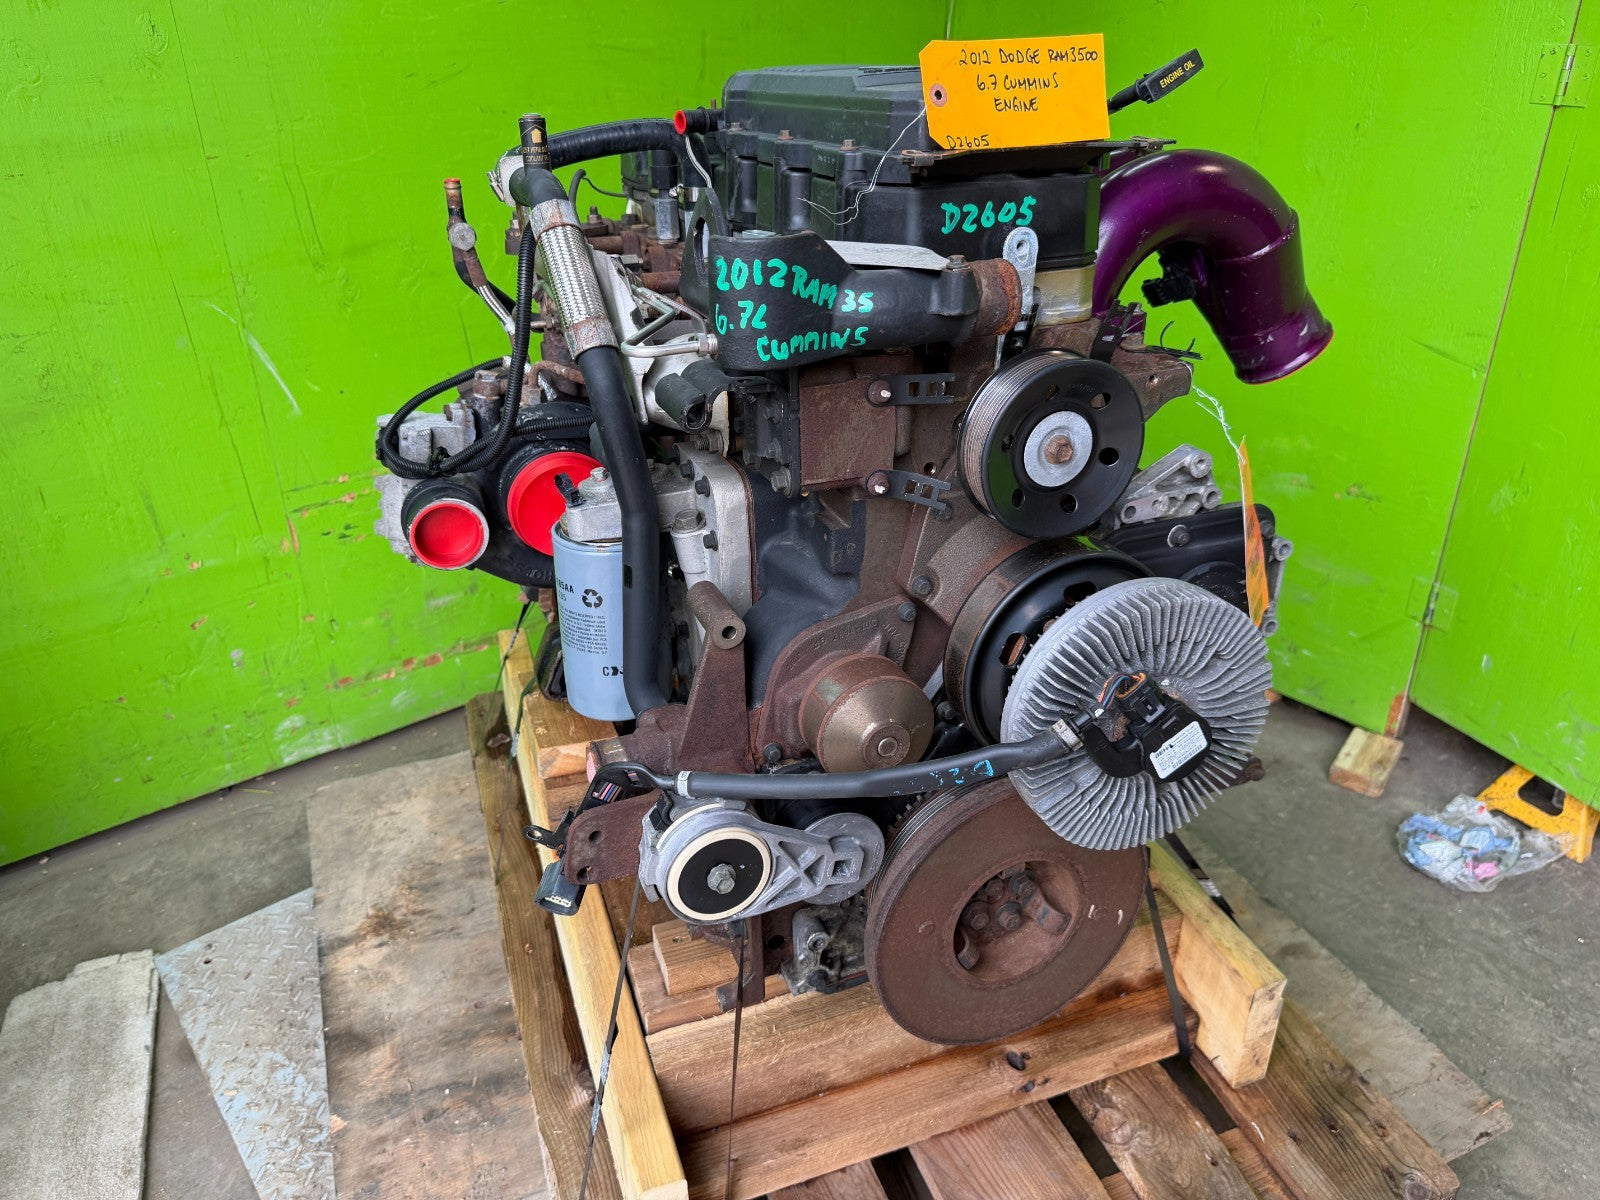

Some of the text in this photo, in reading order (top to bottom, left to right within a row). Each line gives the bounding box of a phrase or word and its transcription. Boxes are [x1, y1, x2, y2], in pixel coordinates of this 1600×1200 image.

[959, 49, 991, 66] 2012
[999, 47, 1041, 64] DODGE
[976, 72, 1059, 91] 6.7 CUMMINS
[1160, 60, 1195, 88] ENGINE OIL
[994, 98, 1039, 113] ENGINE
[946, 134, 990, 149] D2605
[941, 195, 1036, 235] D2605
[715, 256, 874, 313] 2012 RAM 35
[756, 326, 869, 362] CUMMINS
